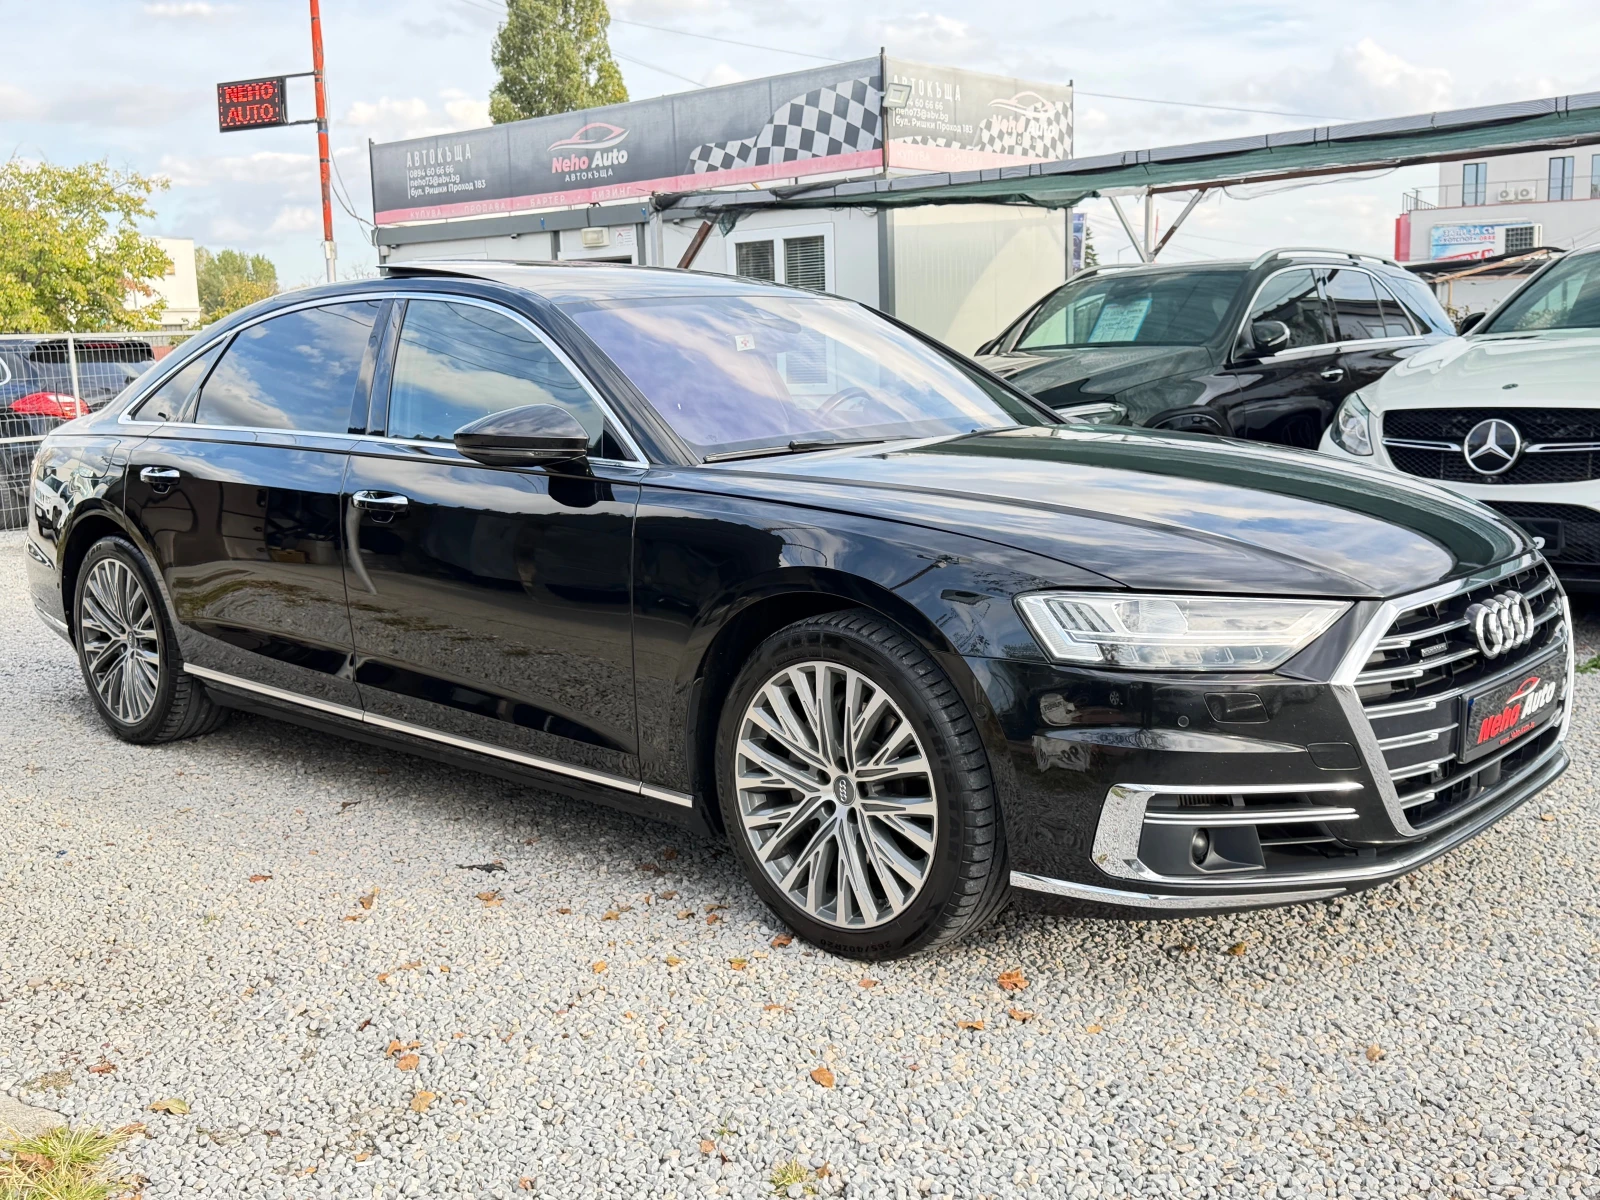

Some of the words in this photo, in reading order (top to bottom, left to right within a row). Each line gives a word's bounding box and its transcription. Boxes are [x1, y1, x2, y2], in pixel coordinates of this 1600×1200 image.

[225, 84, 274, 104] NEHO
[227, 103, 274, 123] AUTO
[962, 124, 973, 134] 183
[406, 143, 472, 168] АВТОКЪЩА
[551, 153, 590, 174] Neho
[591, 148, 628, 169] Auto
[409, 168, 426, 179] 0894
[426, 167, 435, 176] 60
[436, 165, 445, 175] 66
[445, 164, 454, 174] 66
[410, 173, 461, 187] neho73@abv.bg
[564, 168, 614, 182] АВТОКЪЩА
[410, 187, 424, 198] бул.
[425, 185, 448, 195] Ришки
[448, 181, 474, 193] Проход
[474, 179, 486, 189] 183
[591, 186, 632, 200] ЛИЗИНГ
[1477, 703, 1521, 745] Neho
[1521, 681, 1556, 720] Auto
